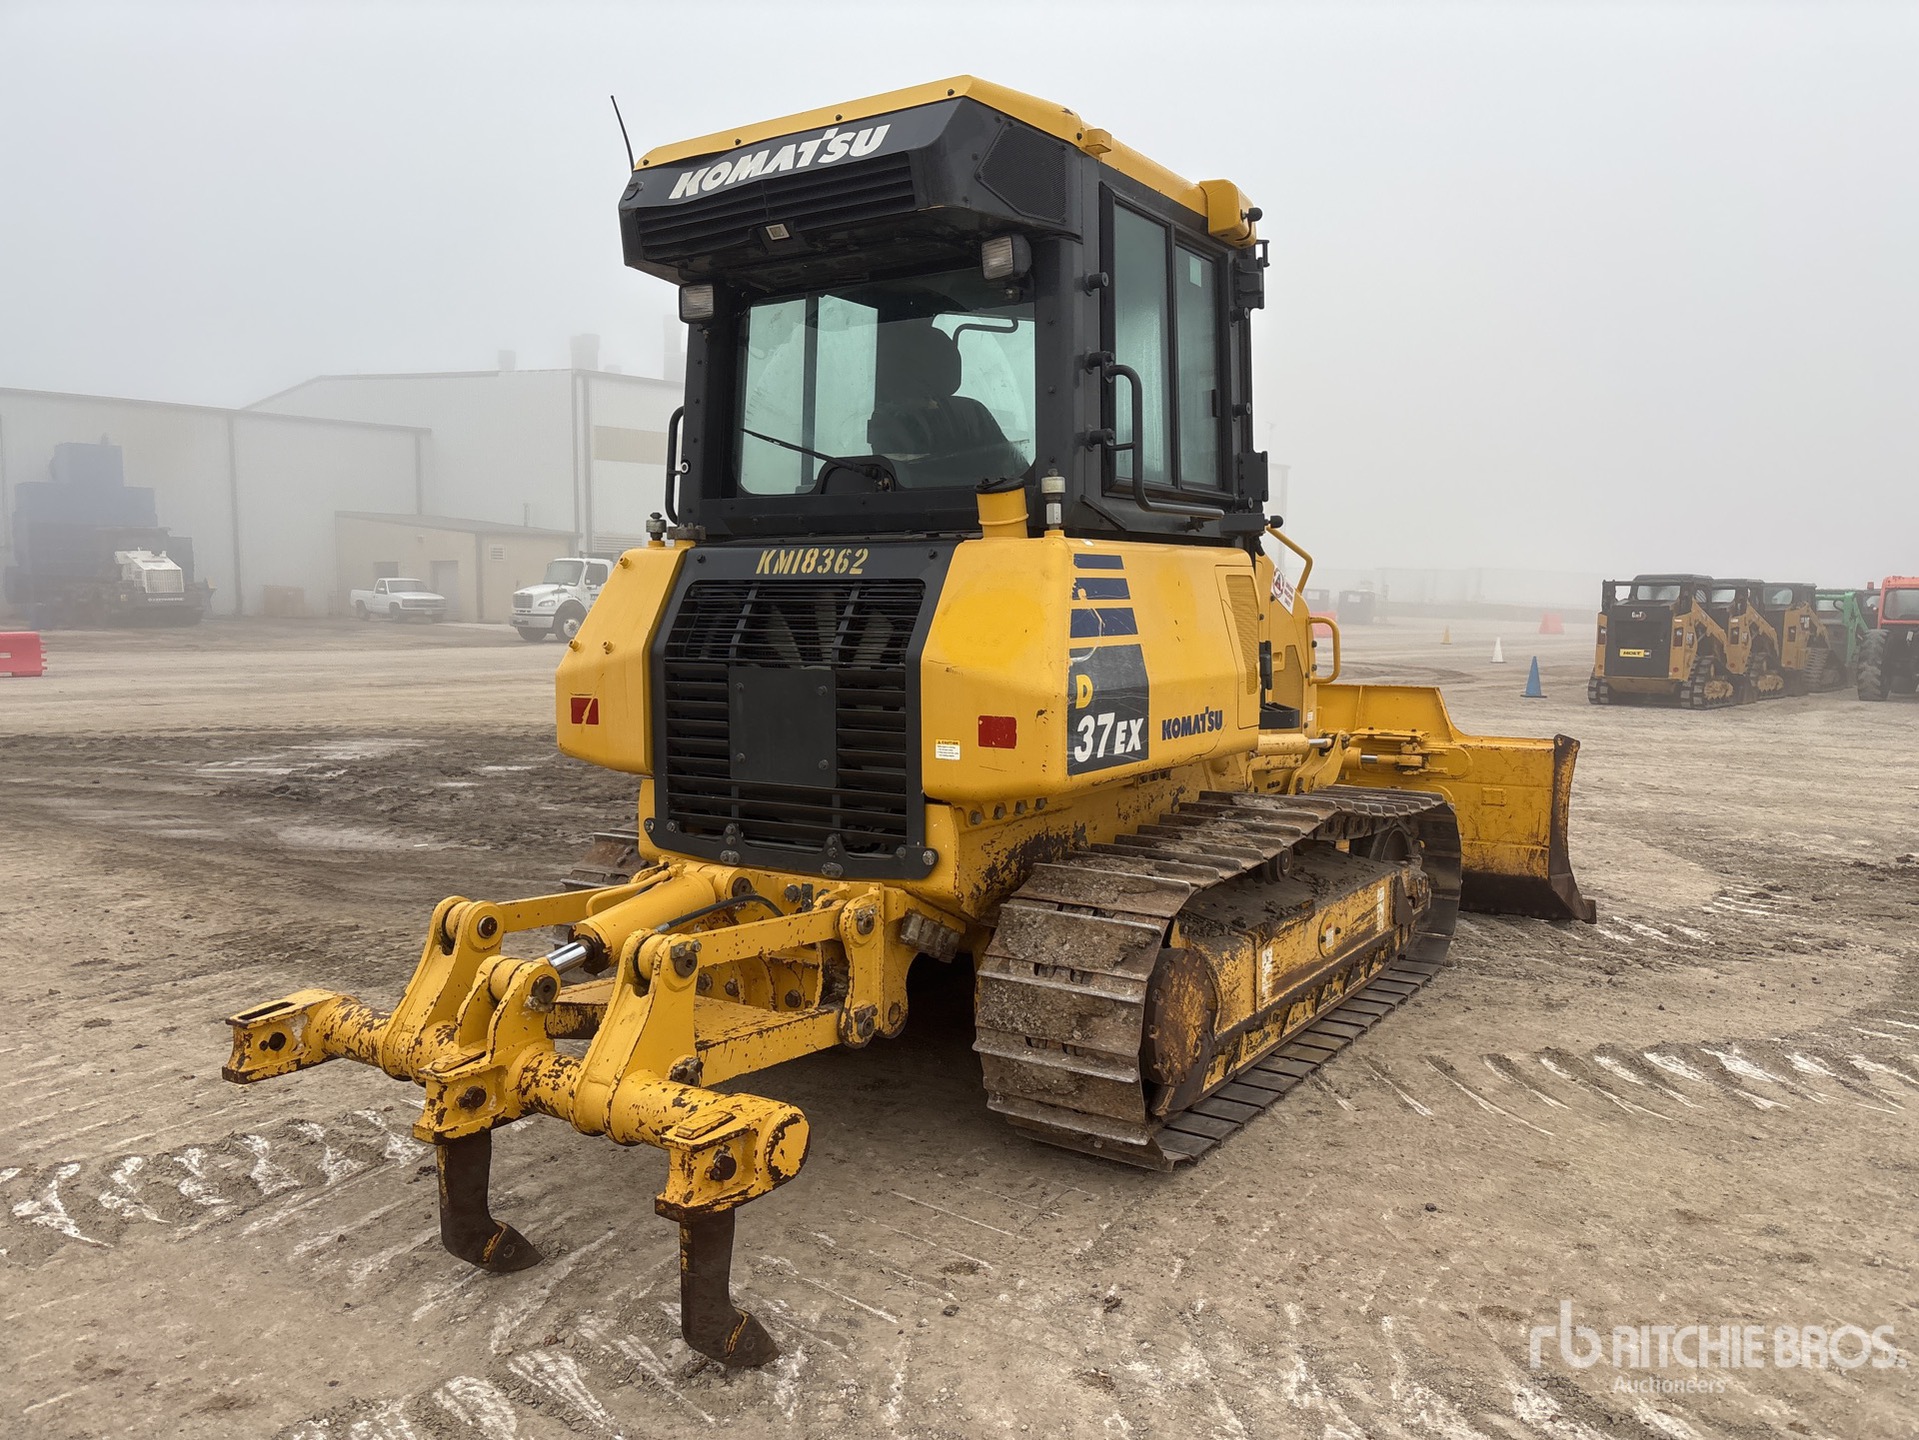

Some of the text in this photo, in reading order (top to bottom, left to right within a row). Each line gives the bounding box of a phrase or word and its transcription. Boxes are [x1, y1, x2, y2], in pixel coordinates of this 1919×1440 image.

[668, 124, 892, 200] KOMATSU
[1075, 674, 1094, 709] D
[1161, 706, 1223, 741] KOMATSU
